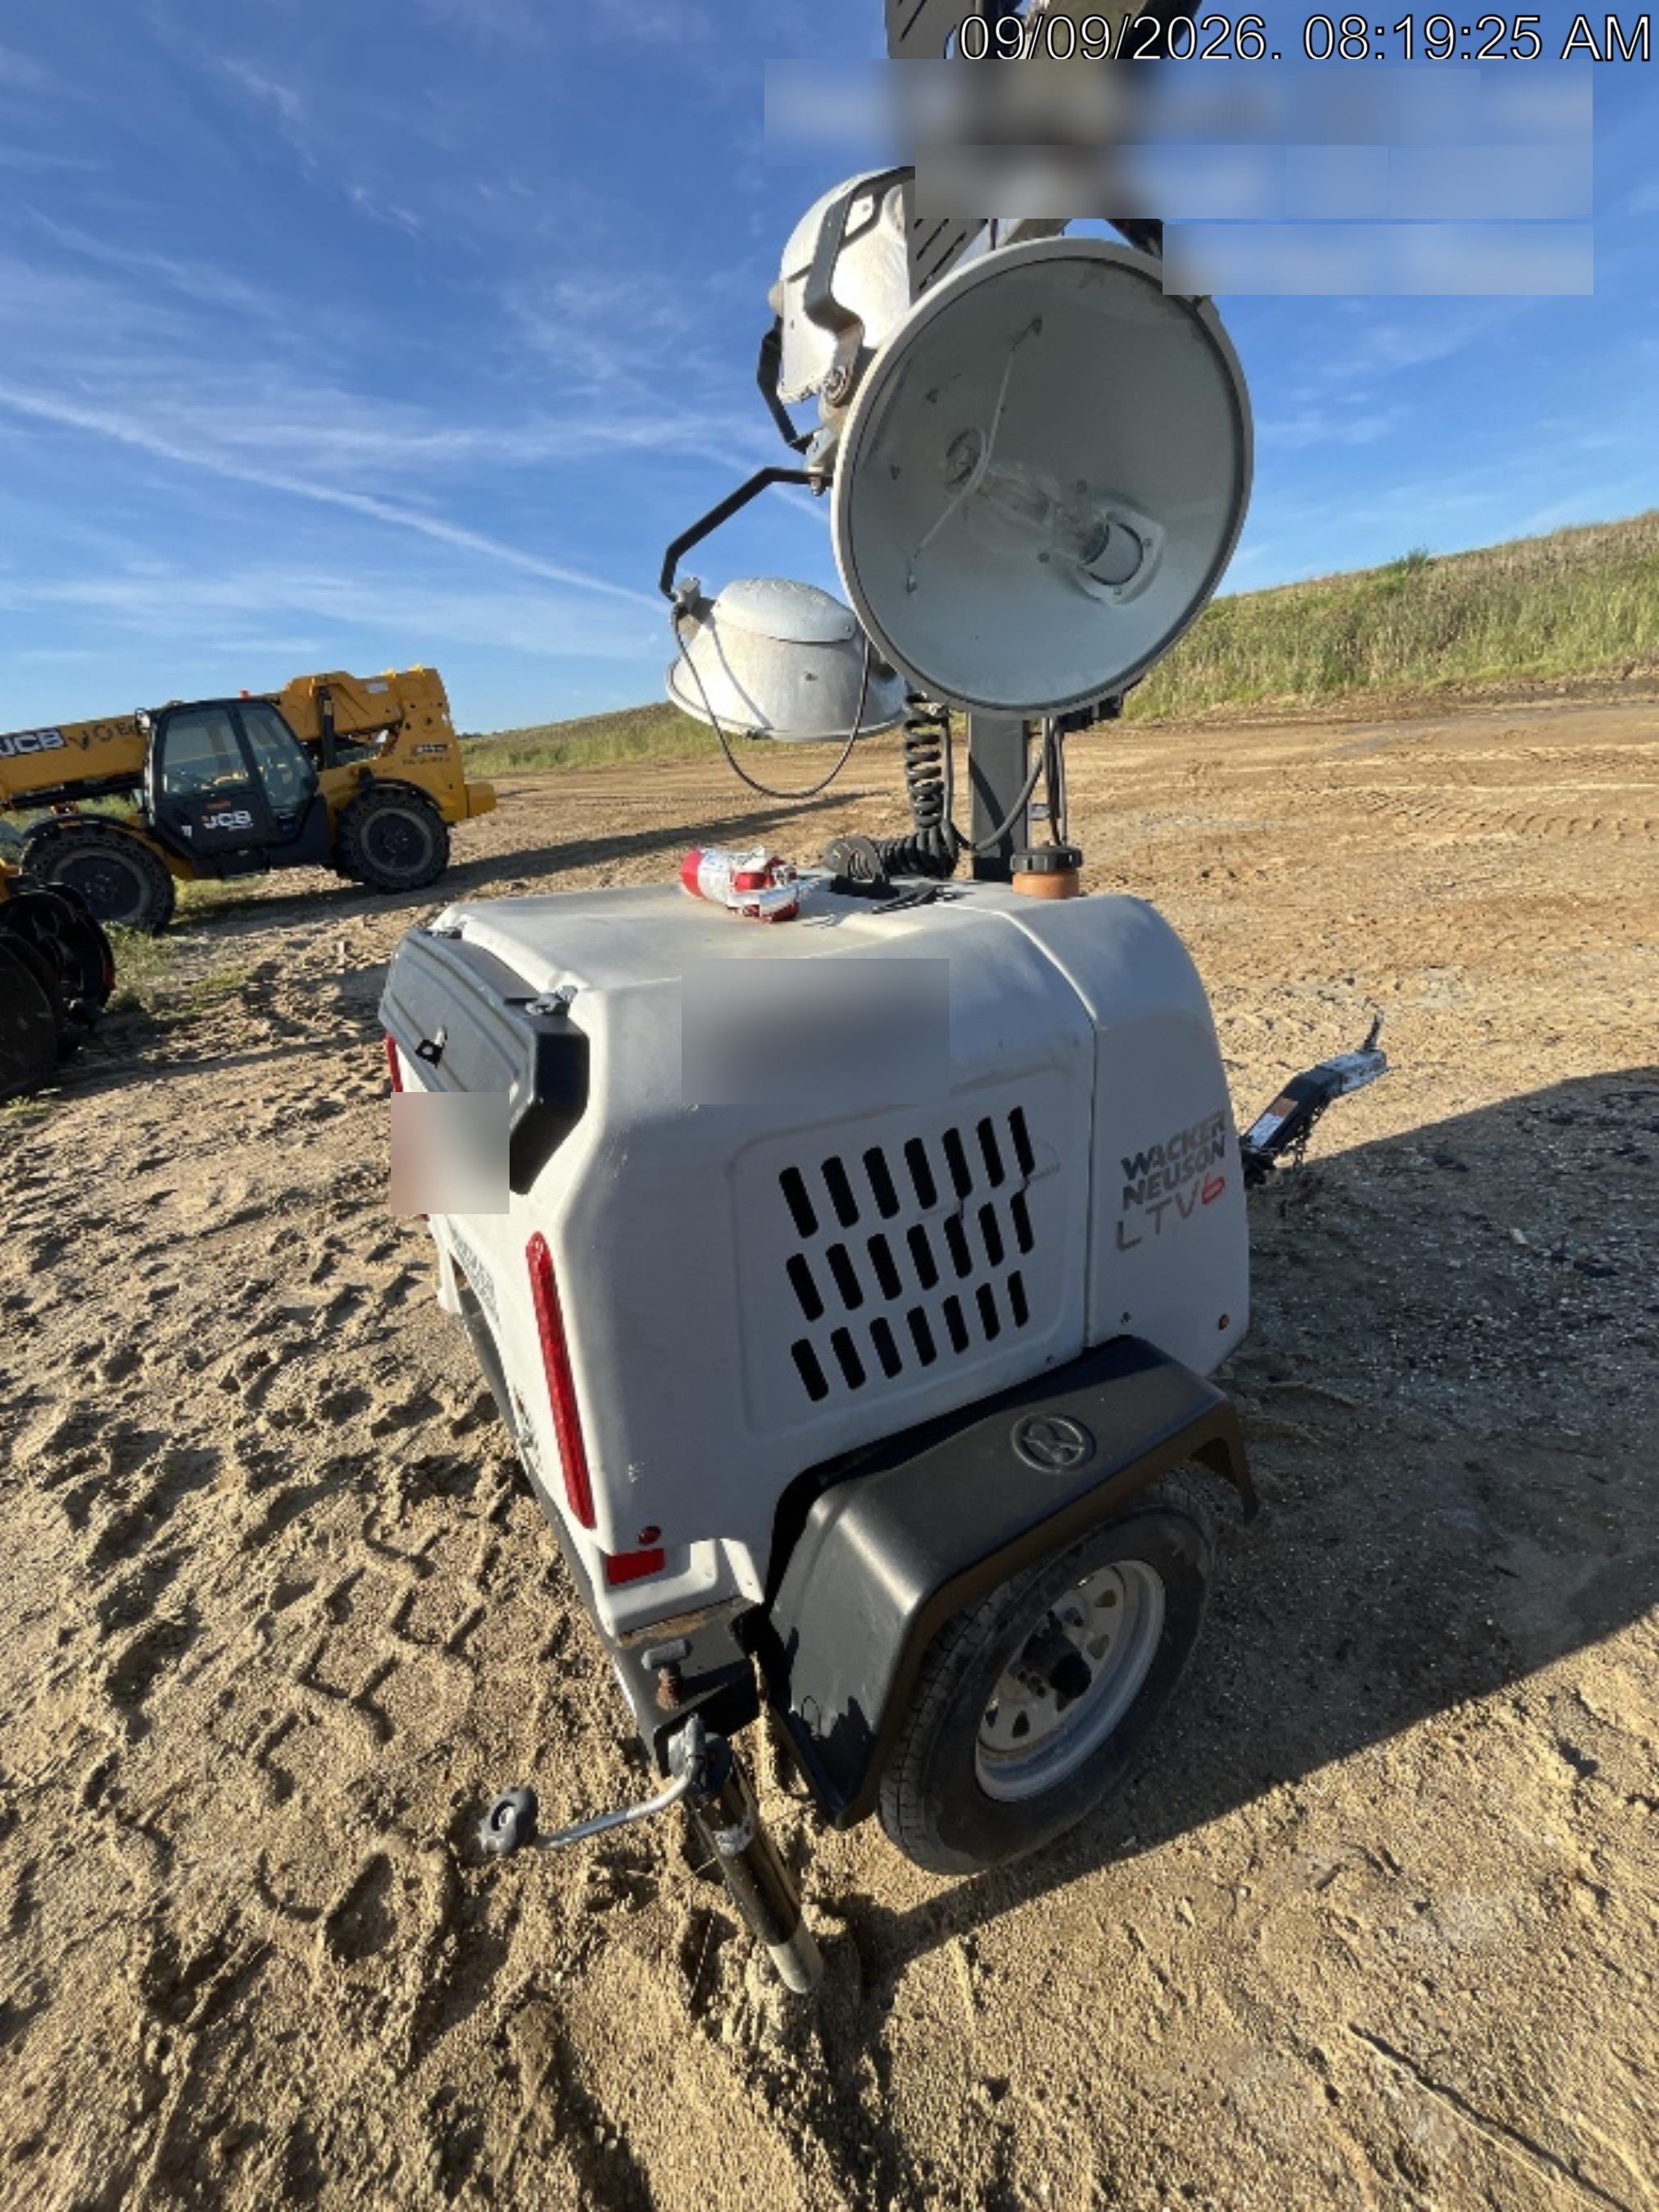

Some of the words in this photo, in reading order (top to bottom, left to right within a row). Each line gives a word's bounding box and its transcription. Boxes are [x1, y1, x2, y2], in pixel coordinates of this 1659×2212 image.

[0, 730, 64, 756] JCB
[203, 810, 252, 829] JCB
[1120, 1109, 1226, 1181] WACKER
[1122, 1135, 1226, 1211] NEUSON
[1115, 1172, 1226, 1252] LTV6
